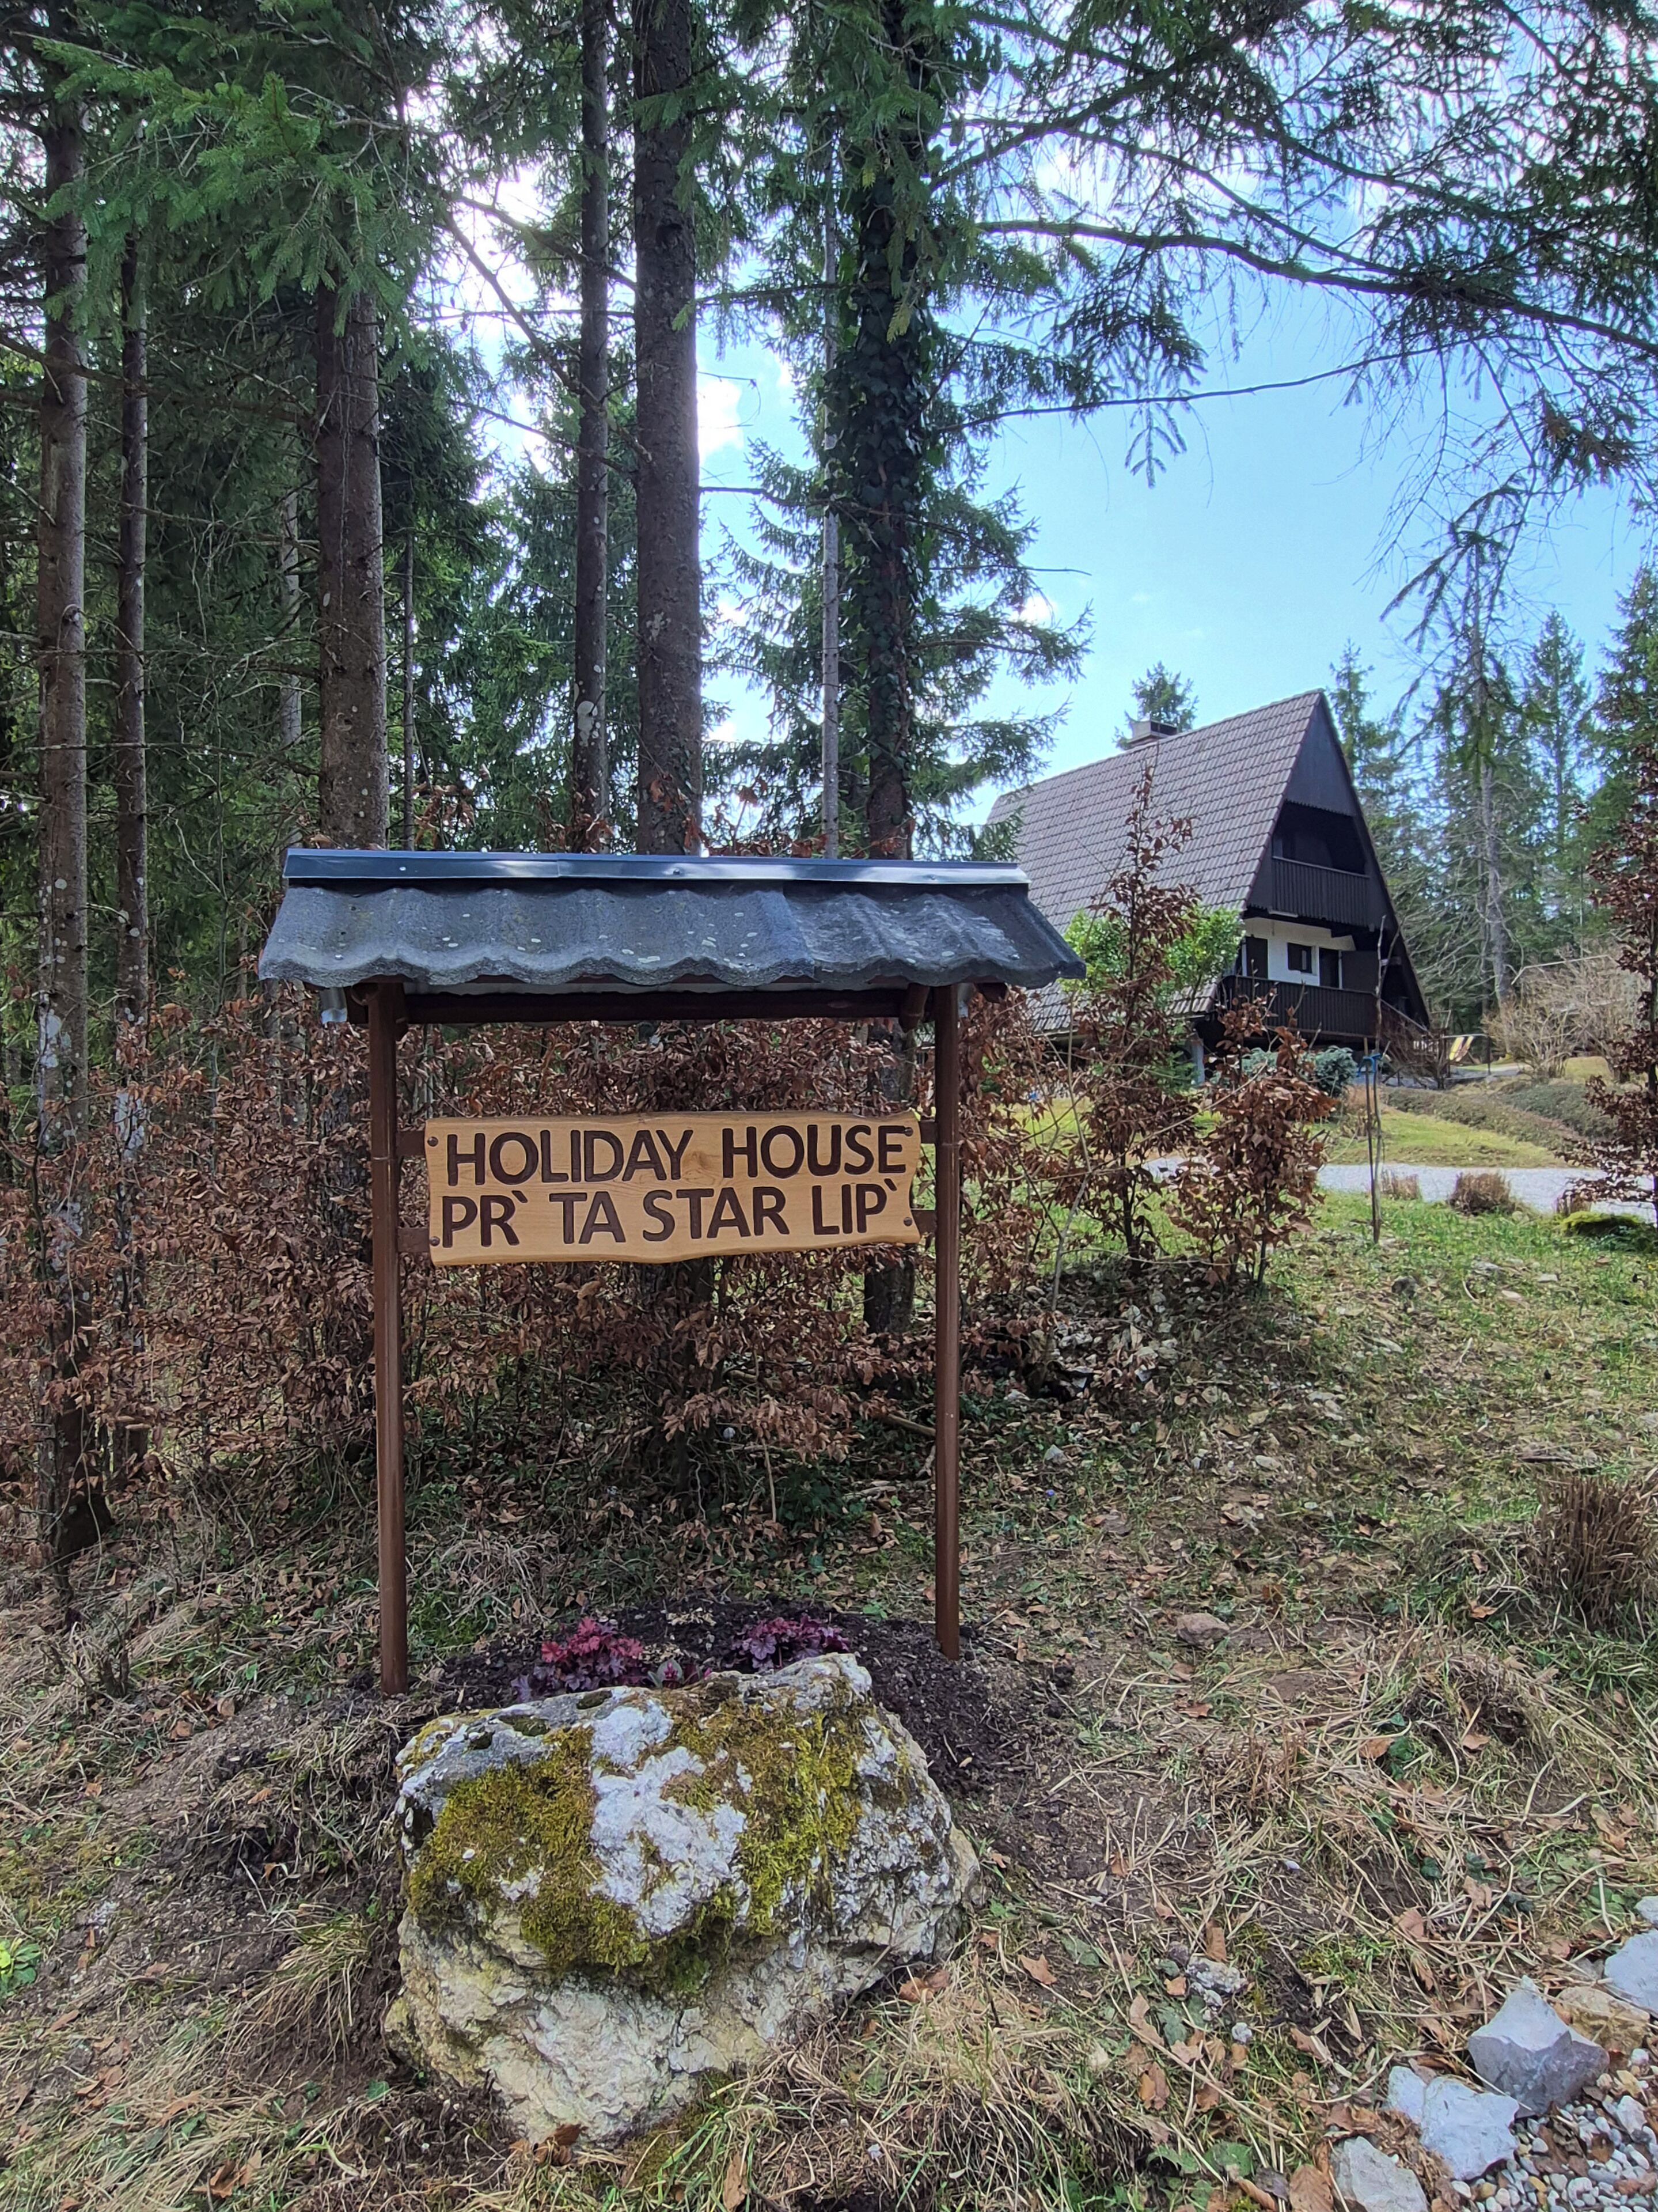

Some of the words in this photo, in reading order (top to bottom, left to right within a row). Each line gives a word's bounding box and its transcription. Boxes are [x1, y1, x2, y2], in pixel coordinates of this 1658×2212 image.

[446, 1128, 694, 1186] HOLIDAY
[722, 1124, 908, 1179] HOUSE
[549, 1190, 627, 1245] TA
[642, 1184, 790, 1242] STAR
